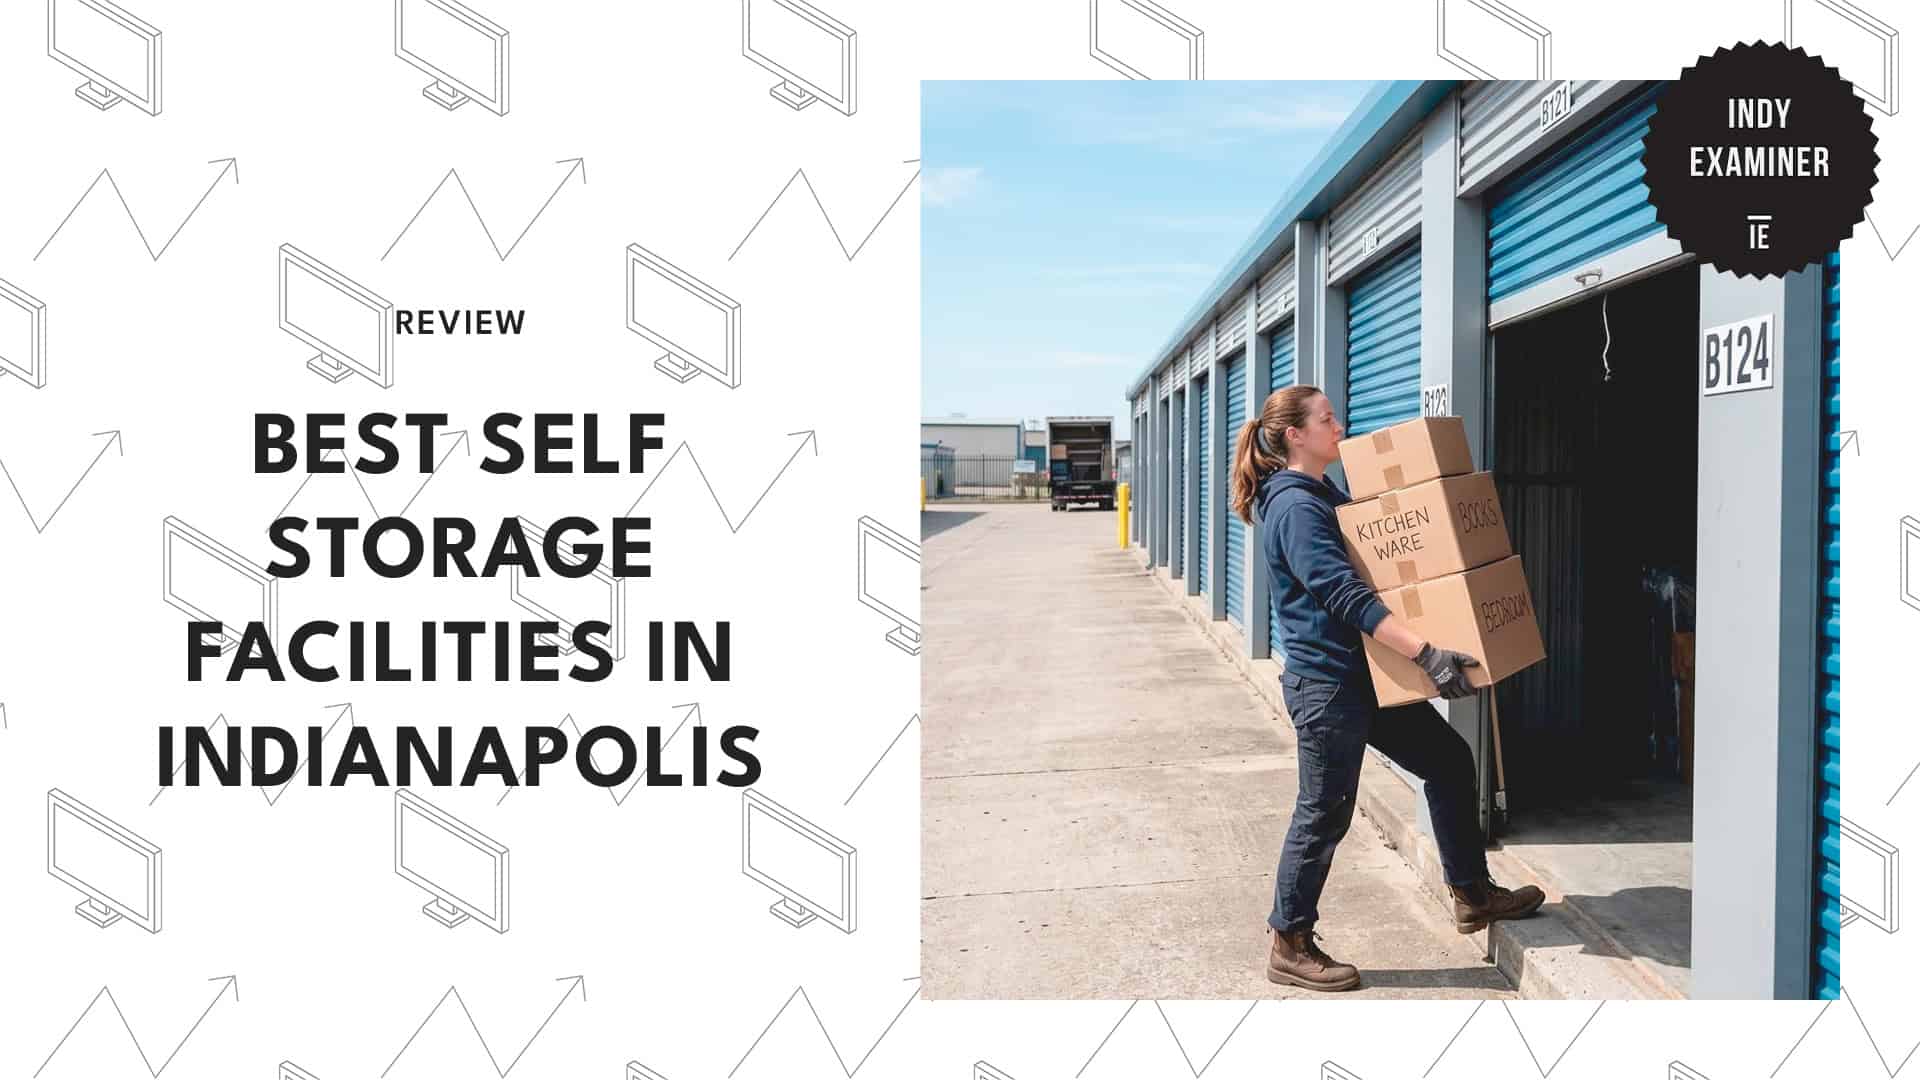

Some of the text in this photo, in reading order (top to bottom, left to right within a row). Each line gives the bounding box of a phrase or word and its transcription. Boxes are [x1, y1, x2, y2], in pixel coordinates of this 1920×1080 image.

[1543, 86, 1567, 126] B121
[1706, 321, 1768, 388] B124
[1425, 388, 1446, 416] B123
[1356, 507, 1431, 543] KITCHEN
[1374, 533, 1425, 560] WARE
